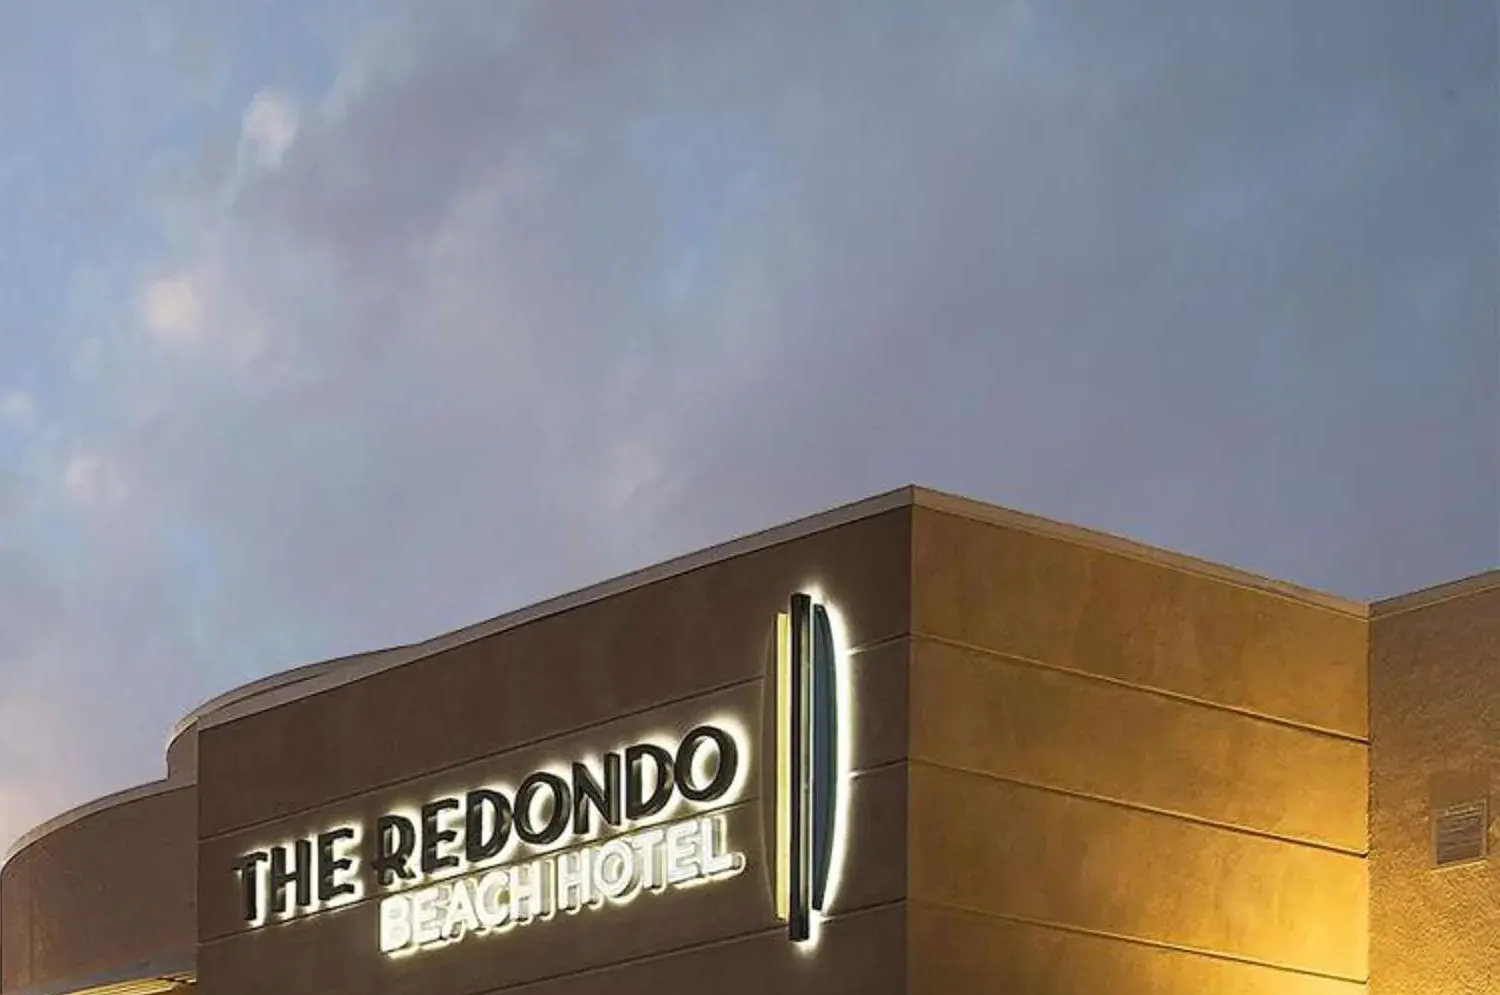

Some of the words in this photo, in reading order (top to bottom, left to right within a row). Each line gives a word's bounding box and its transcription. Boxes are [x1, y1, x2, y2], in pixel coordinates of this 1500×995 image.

[234, 827, 357, 921] THE
[373, 725, 739, 887] REDONDO
[378, 862, 548, 955] BEACH
[556, 815, 743, 910] HOTEL
